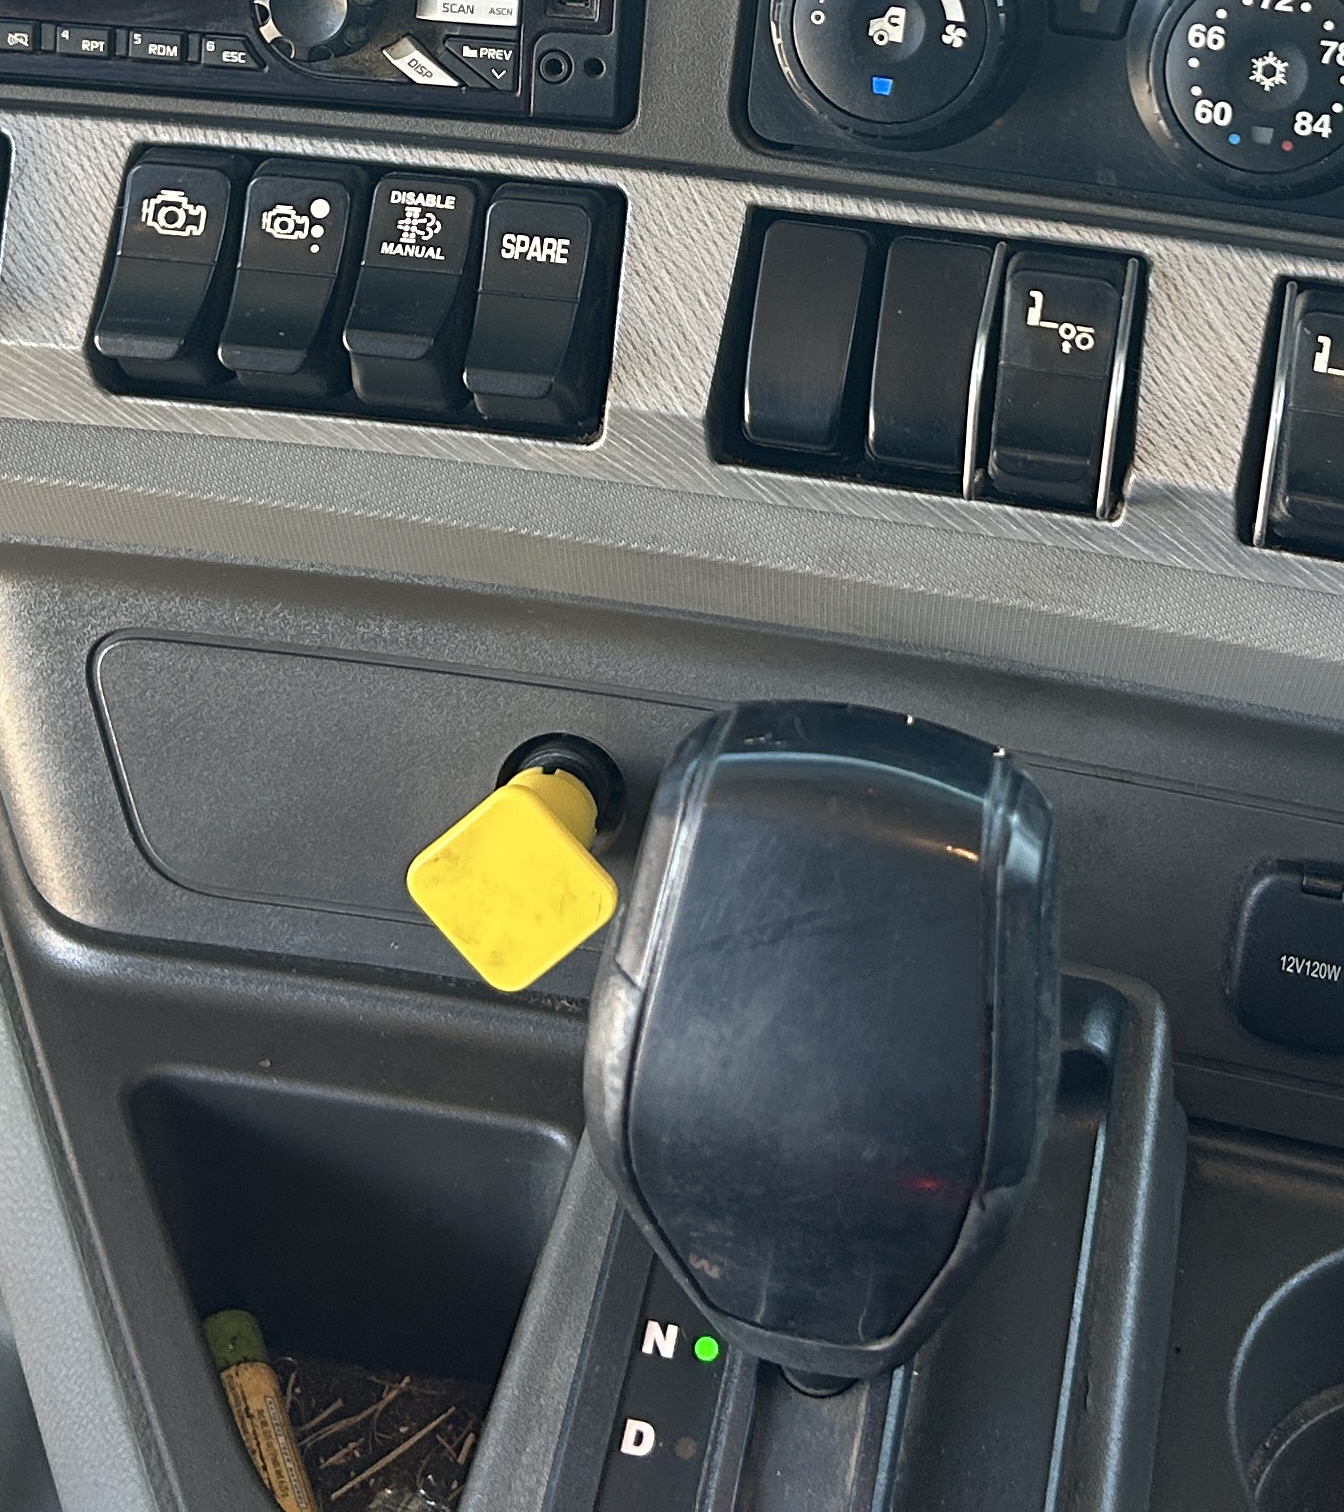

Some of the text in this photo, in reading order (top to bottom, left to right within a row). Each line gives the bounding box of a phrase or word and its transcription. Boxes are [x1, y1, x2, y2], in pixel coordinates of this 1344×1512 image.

[442, 2, 475, 15] SCAN
[60, 29, 70, 40] 4
[133, 34, 143, 45] 5
[1187, 23, 1226, 51] 66
[81, 39, 106, 53] RPT
[149, 44, 179, 58] RDM
[479, 47, 513, 61] PREV
[222, 51, 246, 64] ESC
[406, 56, 434, 81] DISP
[1194, 99, 1233, 127] 60
[1293, 111, 1332, 139] 84
[390, 190, 456, 211] DISABLE
[380, 241, 446, 261] MANUAL
[500, 233, 571, 265] SPARE
[1280, 954, 1342, 982] 12V120W
[641, 1319, 678, 1359] N
[620, 1418, 656, 1457] D
